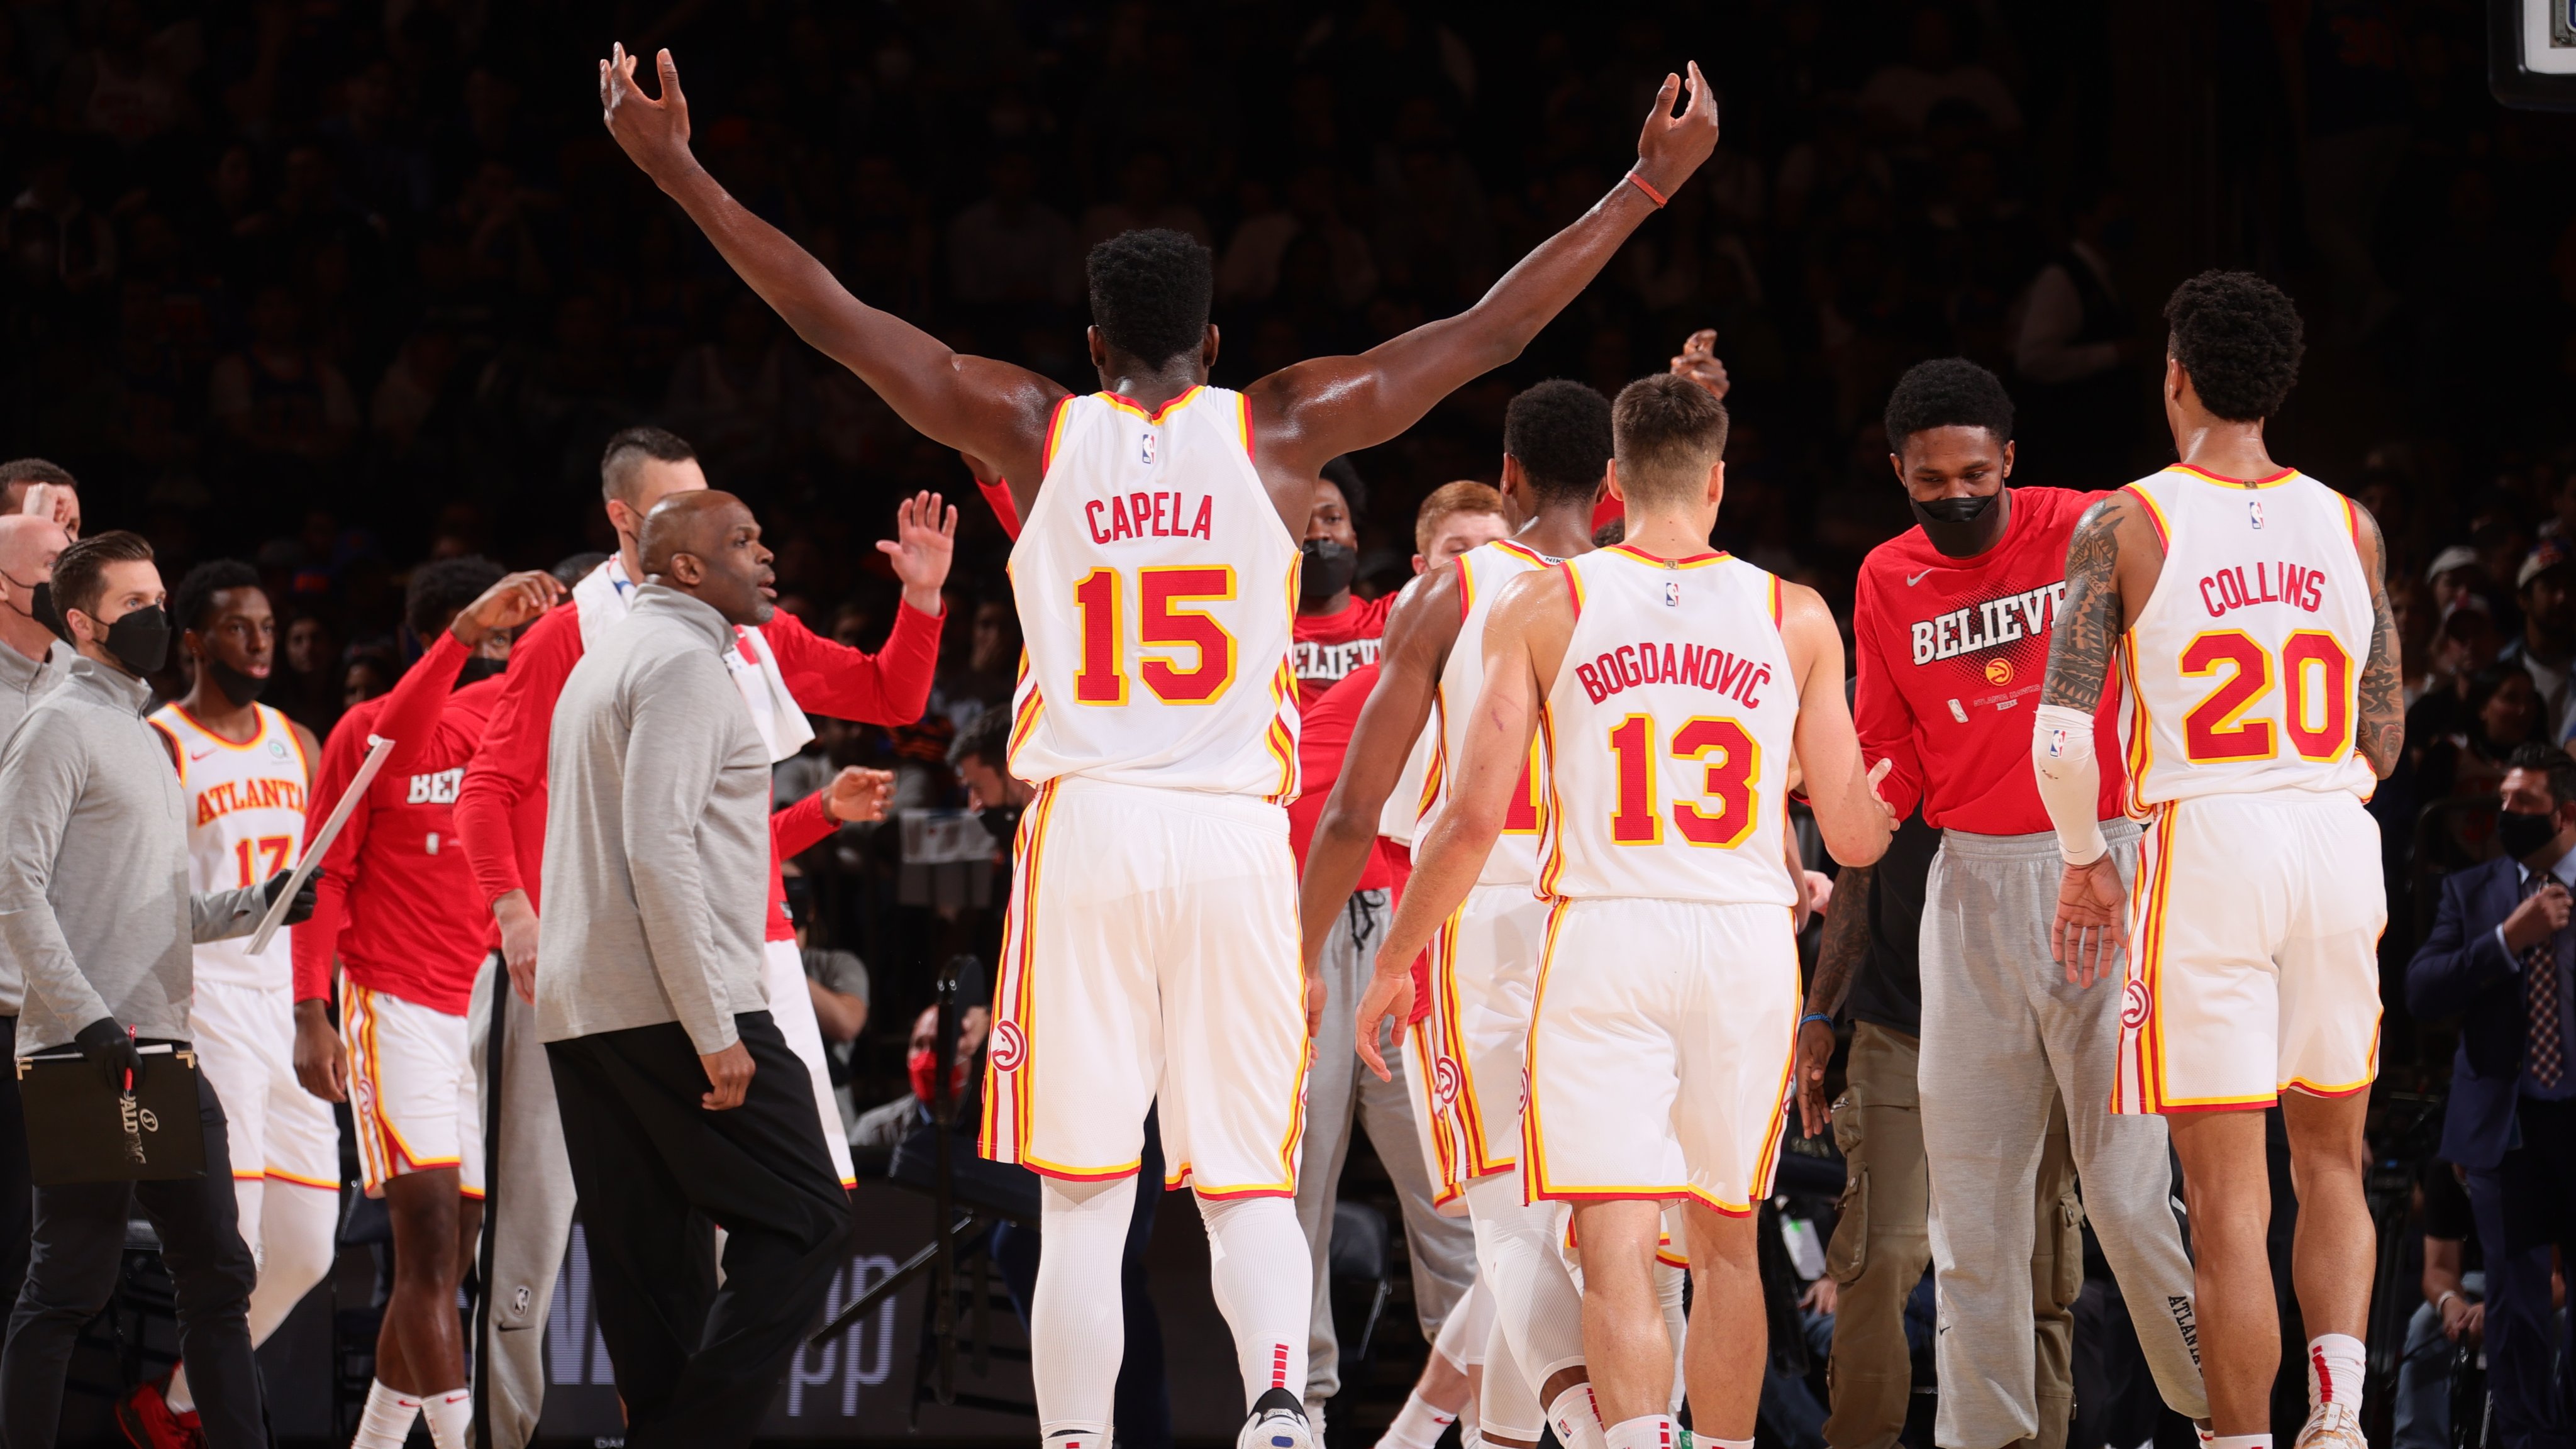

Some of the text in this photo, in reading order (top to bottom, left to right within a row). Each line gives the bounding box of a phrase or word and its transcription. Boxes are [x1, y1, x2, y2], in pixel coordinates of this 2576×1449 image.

[1085, 492, 1213, 545] CAPELA
[2199, 562, 2326, 618] COLLINS
[1073, 564, 1238, 706] 15
[1293, 637, 1382, 680] ELIEV
[2179, 629, 2354, 764] 20
[1609, 713, 1762, 850] 13
[235, 833, 294, 890] 17
